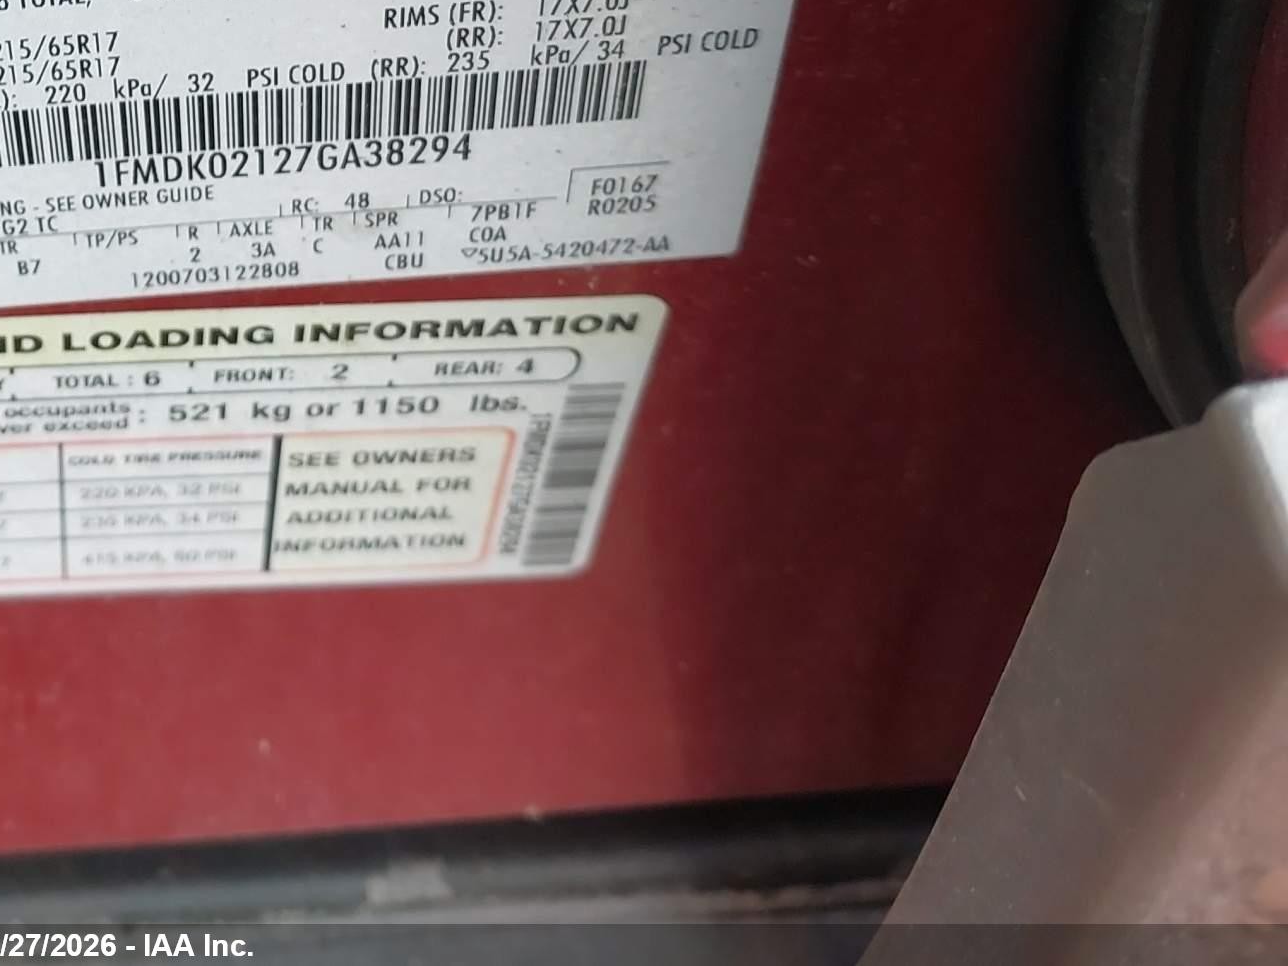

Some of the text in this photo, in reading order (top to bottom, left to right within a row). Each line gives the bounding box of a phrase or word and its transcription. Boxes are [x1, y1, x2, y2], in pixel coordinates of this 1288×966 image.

[382, 4, 439, 29] RIMS
[449, 0, 504, 26] (FR):
[446, 27, 504, 51] (RR):
[45, 83, 86, 105] 220
[113, 73, 167, 100] kPa/
[187, 72, 215, 94] 32
[246, 67, 280, 89] PSI
[289, 61, 344, 85] COLD
[370, 57, 426, 81] (RR):
[446, 50, 490, 73] 235
[530, 42, 586, 66] kPa/
[596, 40, 625, 61] 34
[657, 34, 691, 56] PSI
[701, 27, 759, 51] COLD
[94, 133, 472, 187] 1FMDK02127GA38294
[45, 196, 76, 212] SEE
[82, 190, 149, 210] OWNER
[156, 185, 214, 203] GUIDE
[291, 197, 320, 215] RC:
[344, 192, 370, 209] 48
[419, 188, 462, 205] DSO:
[0, 239, 19, 254] TR
[187, 224, 199, 241] R
[229, 220, 273, 237] AXLE
[314, 215, 333, 231] TR
[364, 212, 398, 227] SPR
[190, 248, 200, 263] 2
[251, 243, 276, 258] 3A
[313, 239, 323, 254] C
[385, 253, 424, 269] CBU
[61, 325, 274, 353] LOADING
[293, 313, 639, 343] INFORMATION
[55, 374, 116, 390] TOTAL
[143, 369, 161, 387] 6
[214, 365, 294, 383] FRONT:
[331, 362, 349, 381] 2
[434, 360, 502, 377] REAR:
[516, 356, 535, 374] 4
[4, 401, 130, 421] occupants
[169, 403, 228, 422] 521
[251, 401, 291, 422] kg
[306, 400, 339, 417] or
[352, 396, 440, 416] 1150
[469, 394, 528, 413] lbs.
[43, 417, 130, 433] exceed
[287, 447, 476, 468] SEE OWNERS
[285, 476, 471, 496] MANUAL FOR
[286, 507, 453, 525] ADDITIONAL
[272, 533, 466, 553] INFORMATION
